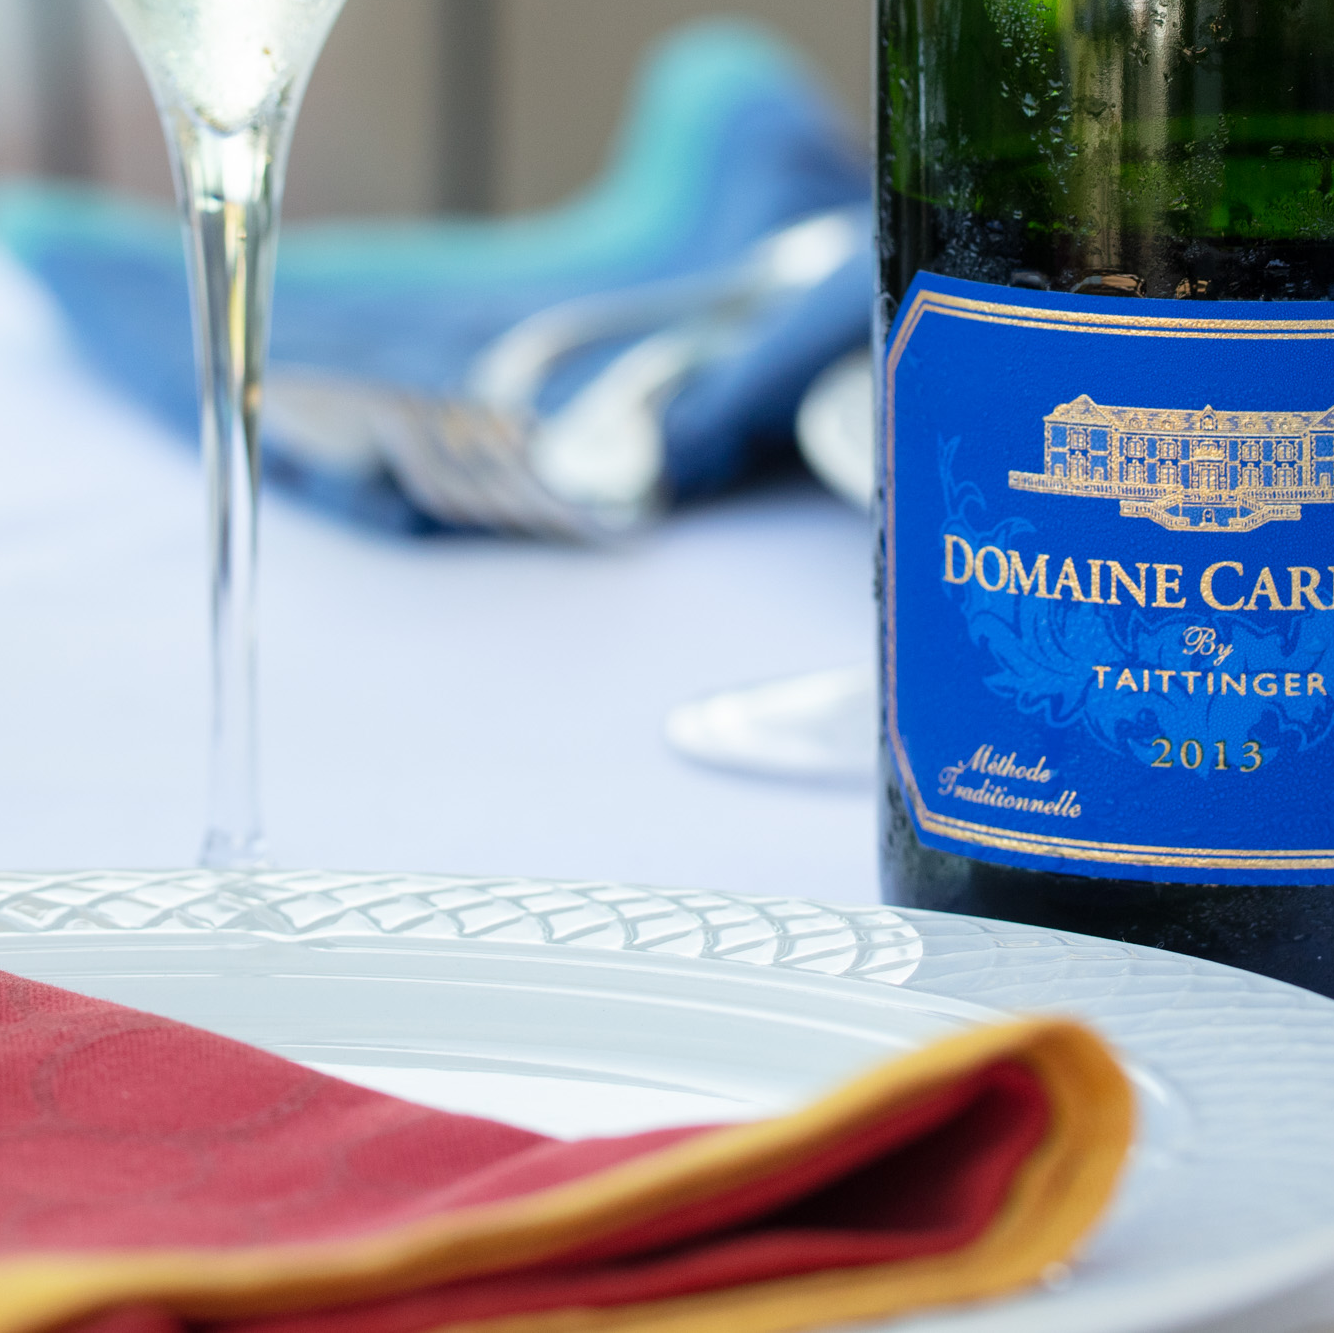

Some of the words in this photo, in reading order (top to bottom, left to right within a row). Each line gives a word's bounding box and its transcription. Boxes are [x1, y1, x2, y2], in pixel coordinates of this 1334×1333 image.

[943, 534, 1188, 610] DOMAINE
[1182, 626, 1234, 665] By
[1093, 665, 1328, 697] TAITTINGER
[957, 743, 1052, 784] Méthode
[1150, 738, 1263, 773] 2013
[937, 766, 1082, 818] Traditionnelle
